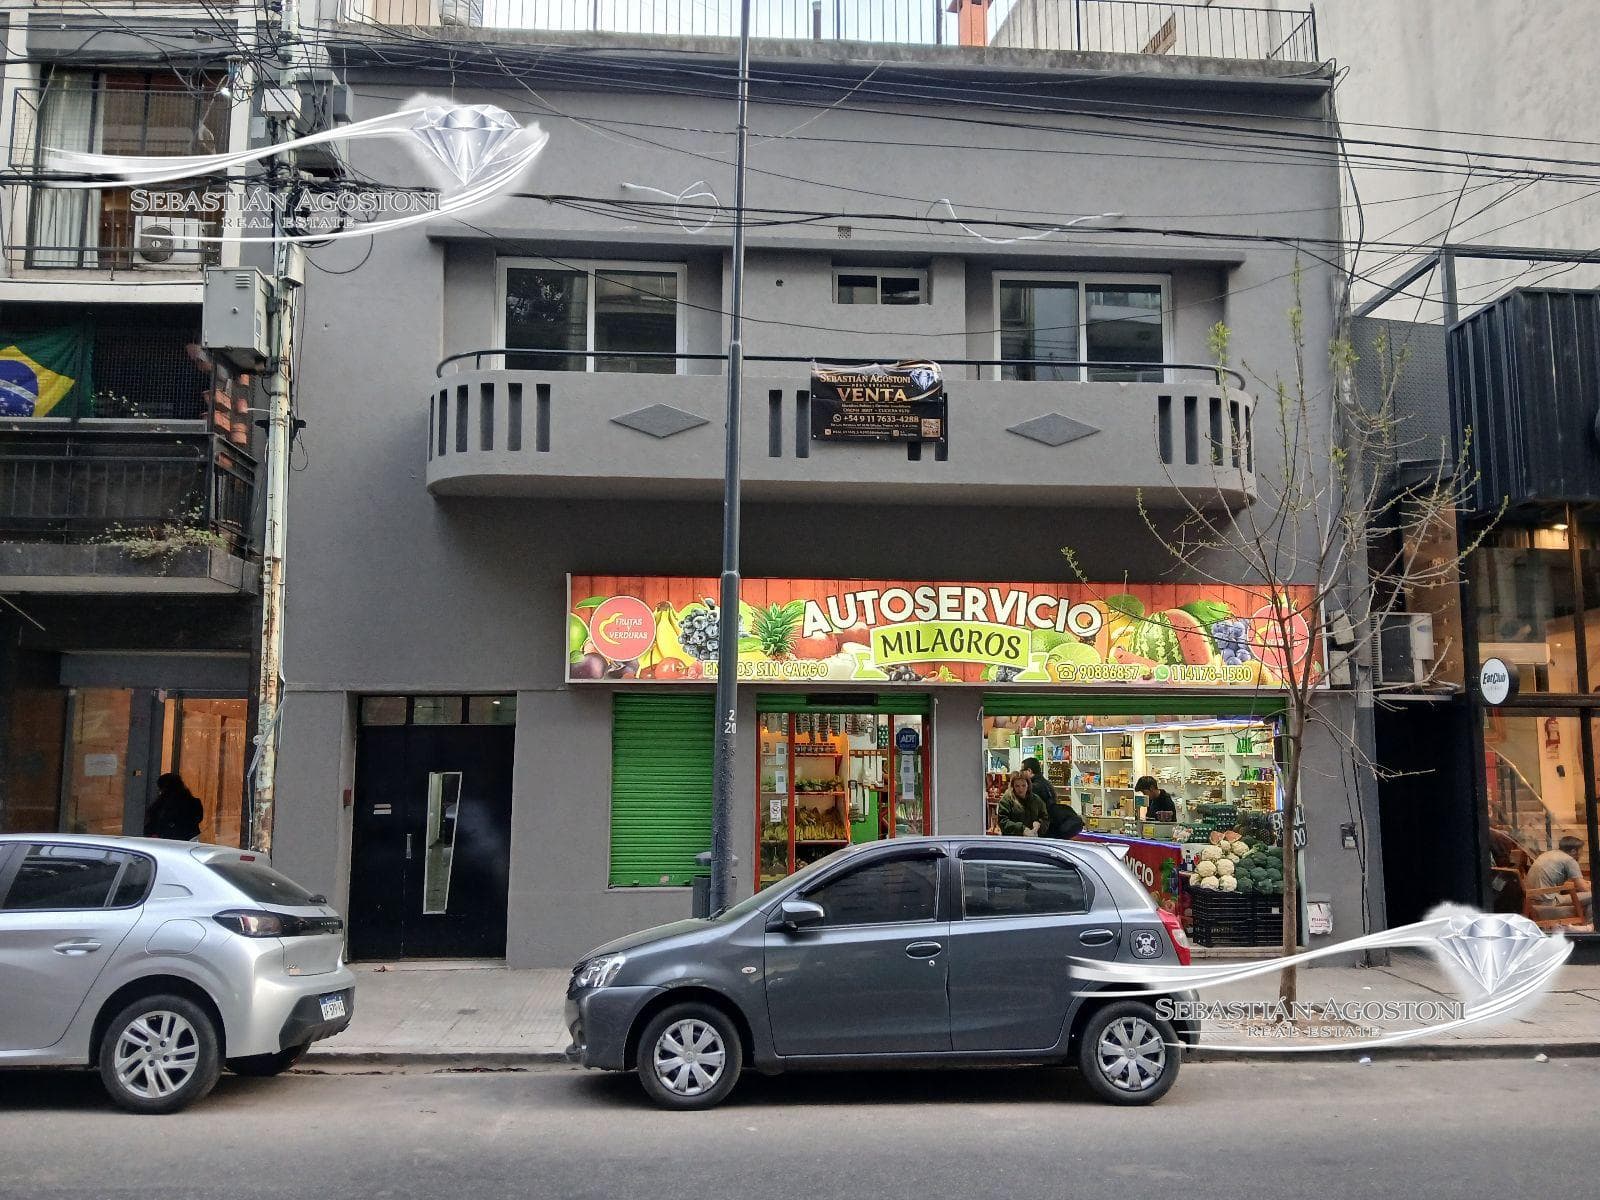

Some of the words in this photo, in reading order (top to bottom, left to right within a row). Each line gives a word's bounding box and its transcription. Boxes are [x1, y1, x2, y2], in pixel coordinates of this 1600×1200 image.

[870, 374, 911, 384] AGOSTONI
[837, 387, 908, 402] VENTA
[802, 586, 1103, 638] AUTOSERVICIO
[615, 618, 643, 626] FRUTAS
[609, 631, 648, 640] VERDURAS
[881, 627, 1022, 660] MILAGROS
[704, 661, 753, 677] ENOS
[757, 661, 780, 677] SIN
[783, 661, 829, 678] CARGO
[1078, 665, 1140, 680] 90886857
[1171, 665, 1252, 681] 114178-1580
